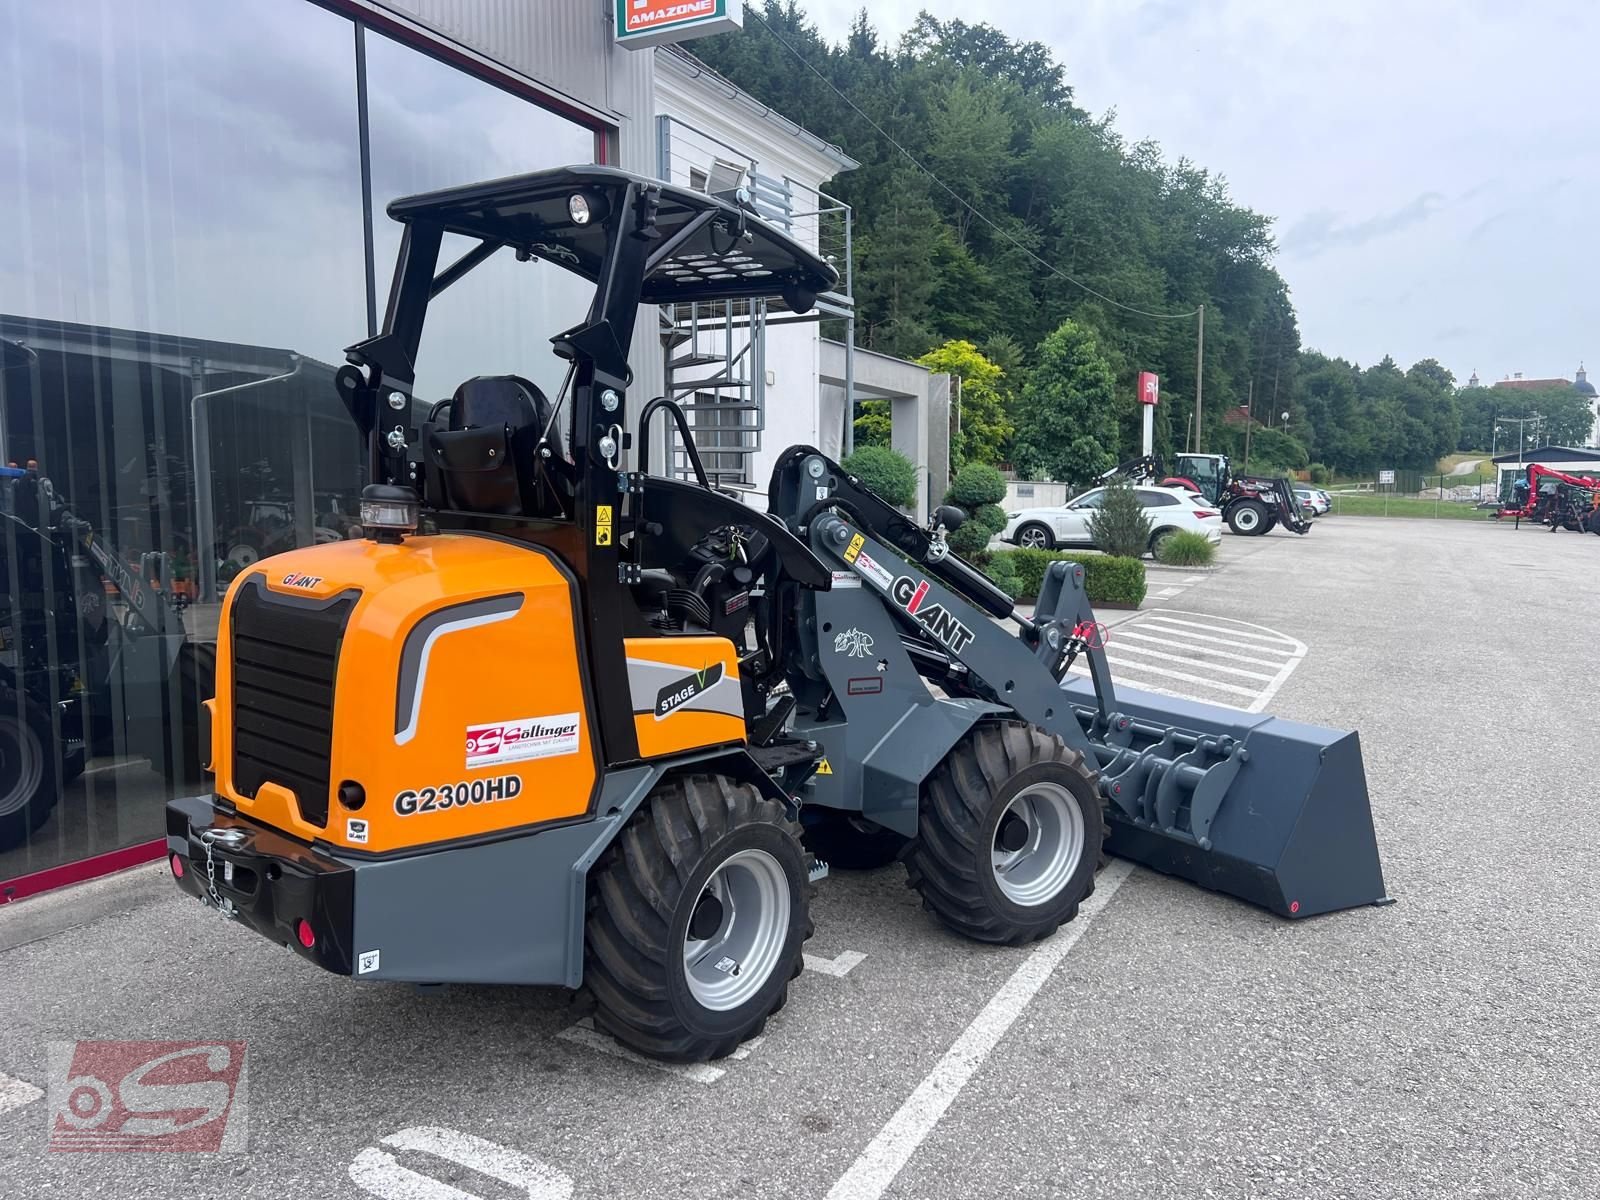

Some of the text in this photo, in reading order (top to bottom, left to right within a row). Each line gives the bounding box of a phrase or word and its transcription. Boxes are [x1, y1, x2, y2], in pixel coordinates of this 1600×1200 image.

[629, 1, 712, 25] AMAZONE
[661, 684, 695, 711] STAGE
[504, 724, 577, 744] Söllinger
[395, 775, 521, 816] G2300HD
